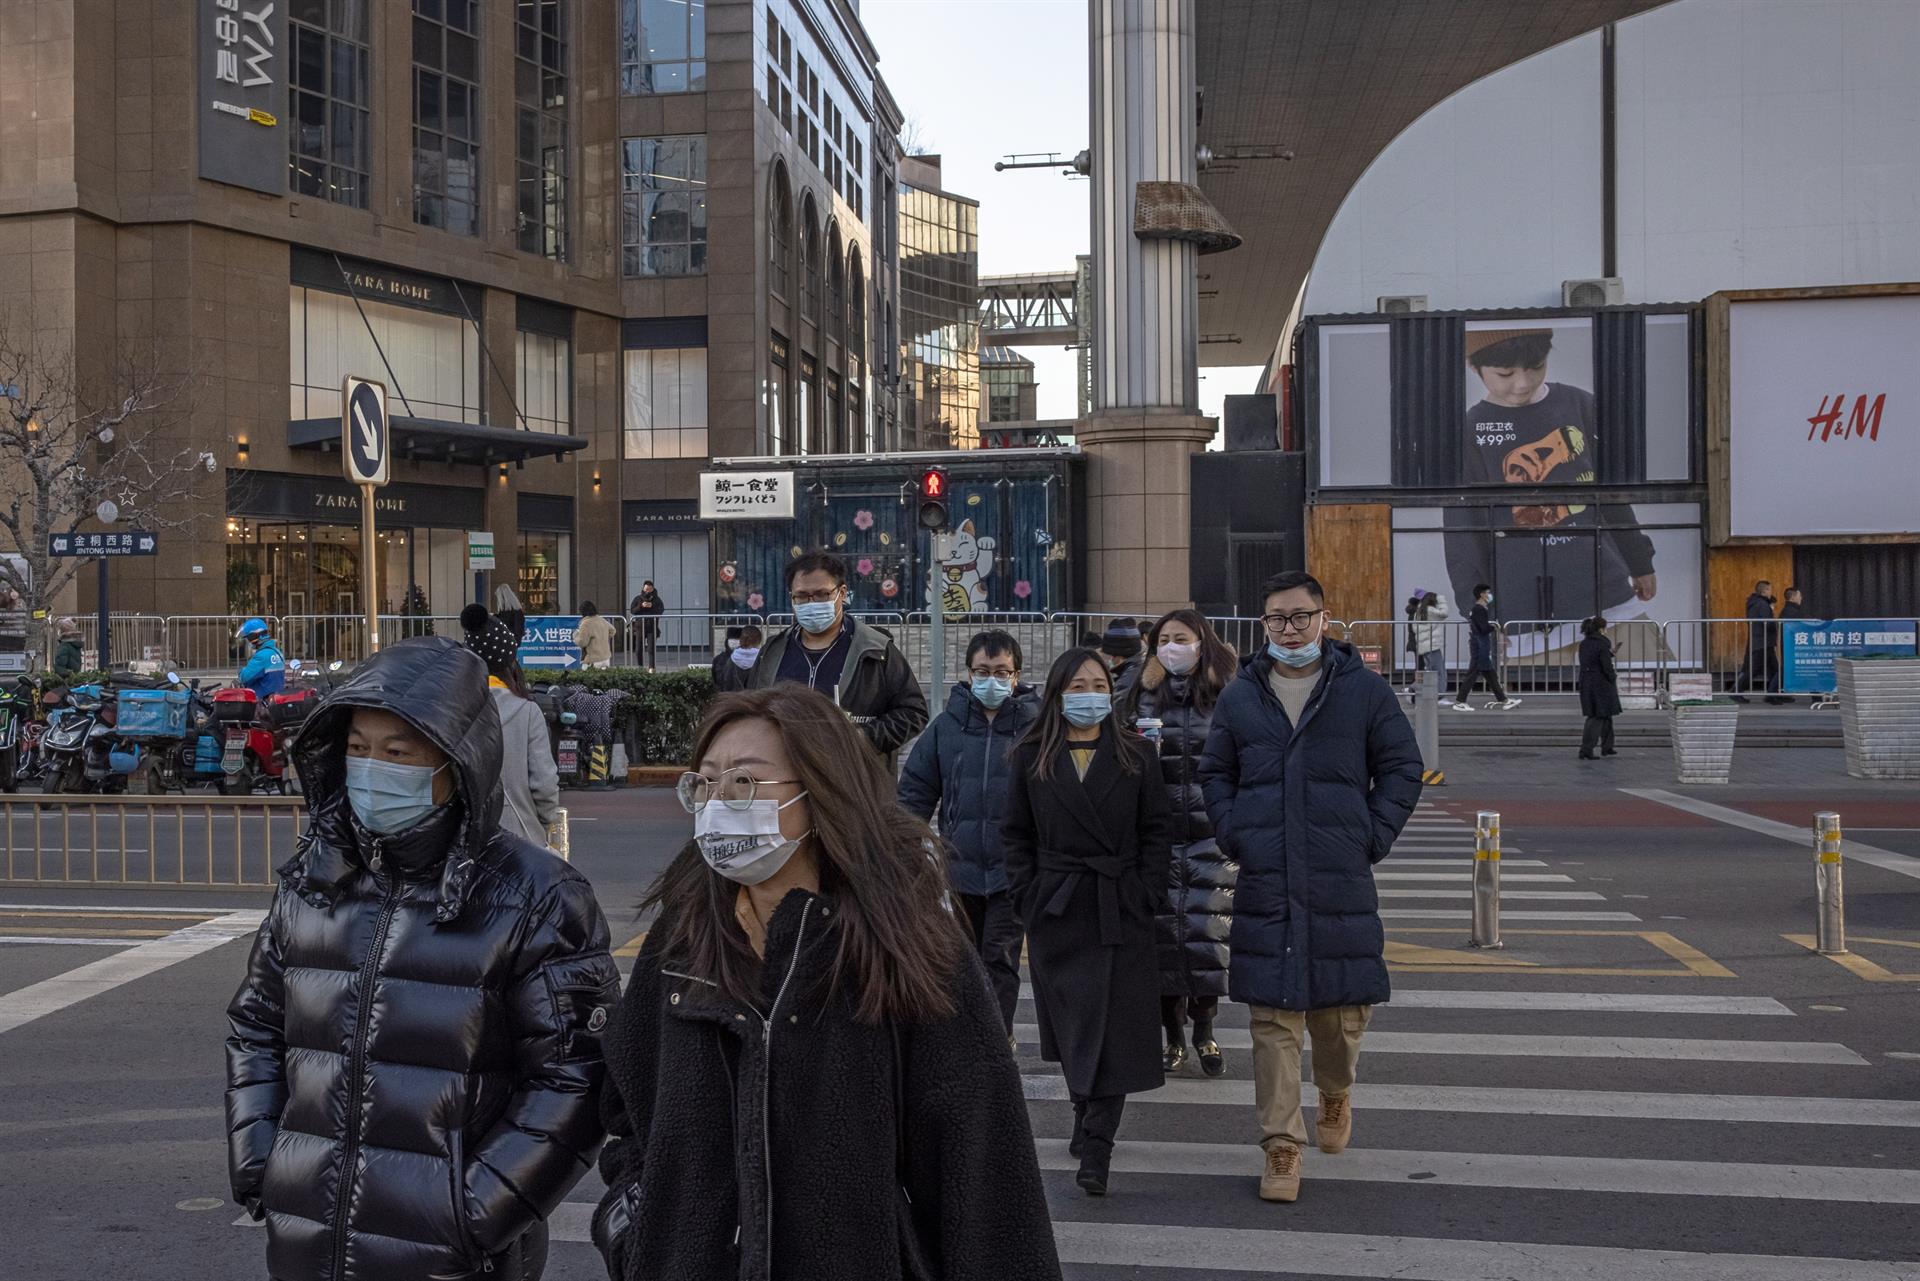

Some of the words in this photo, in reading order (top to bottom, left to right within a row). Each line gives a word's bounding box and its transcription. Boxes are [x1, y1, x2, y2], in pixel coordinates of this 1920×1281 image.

[390, 281, 432, 300] HOME
[1807, 393, 1886, 442] H&M
[1476, 422, 1514, 431] 印花卫衣
[315, 494, 357, 508] ZARA
[375, 498, 407, 511] OME
[74, 535, 133, 547] 金桐西路
[1794, 631, 1863, 646] 疫情防控
